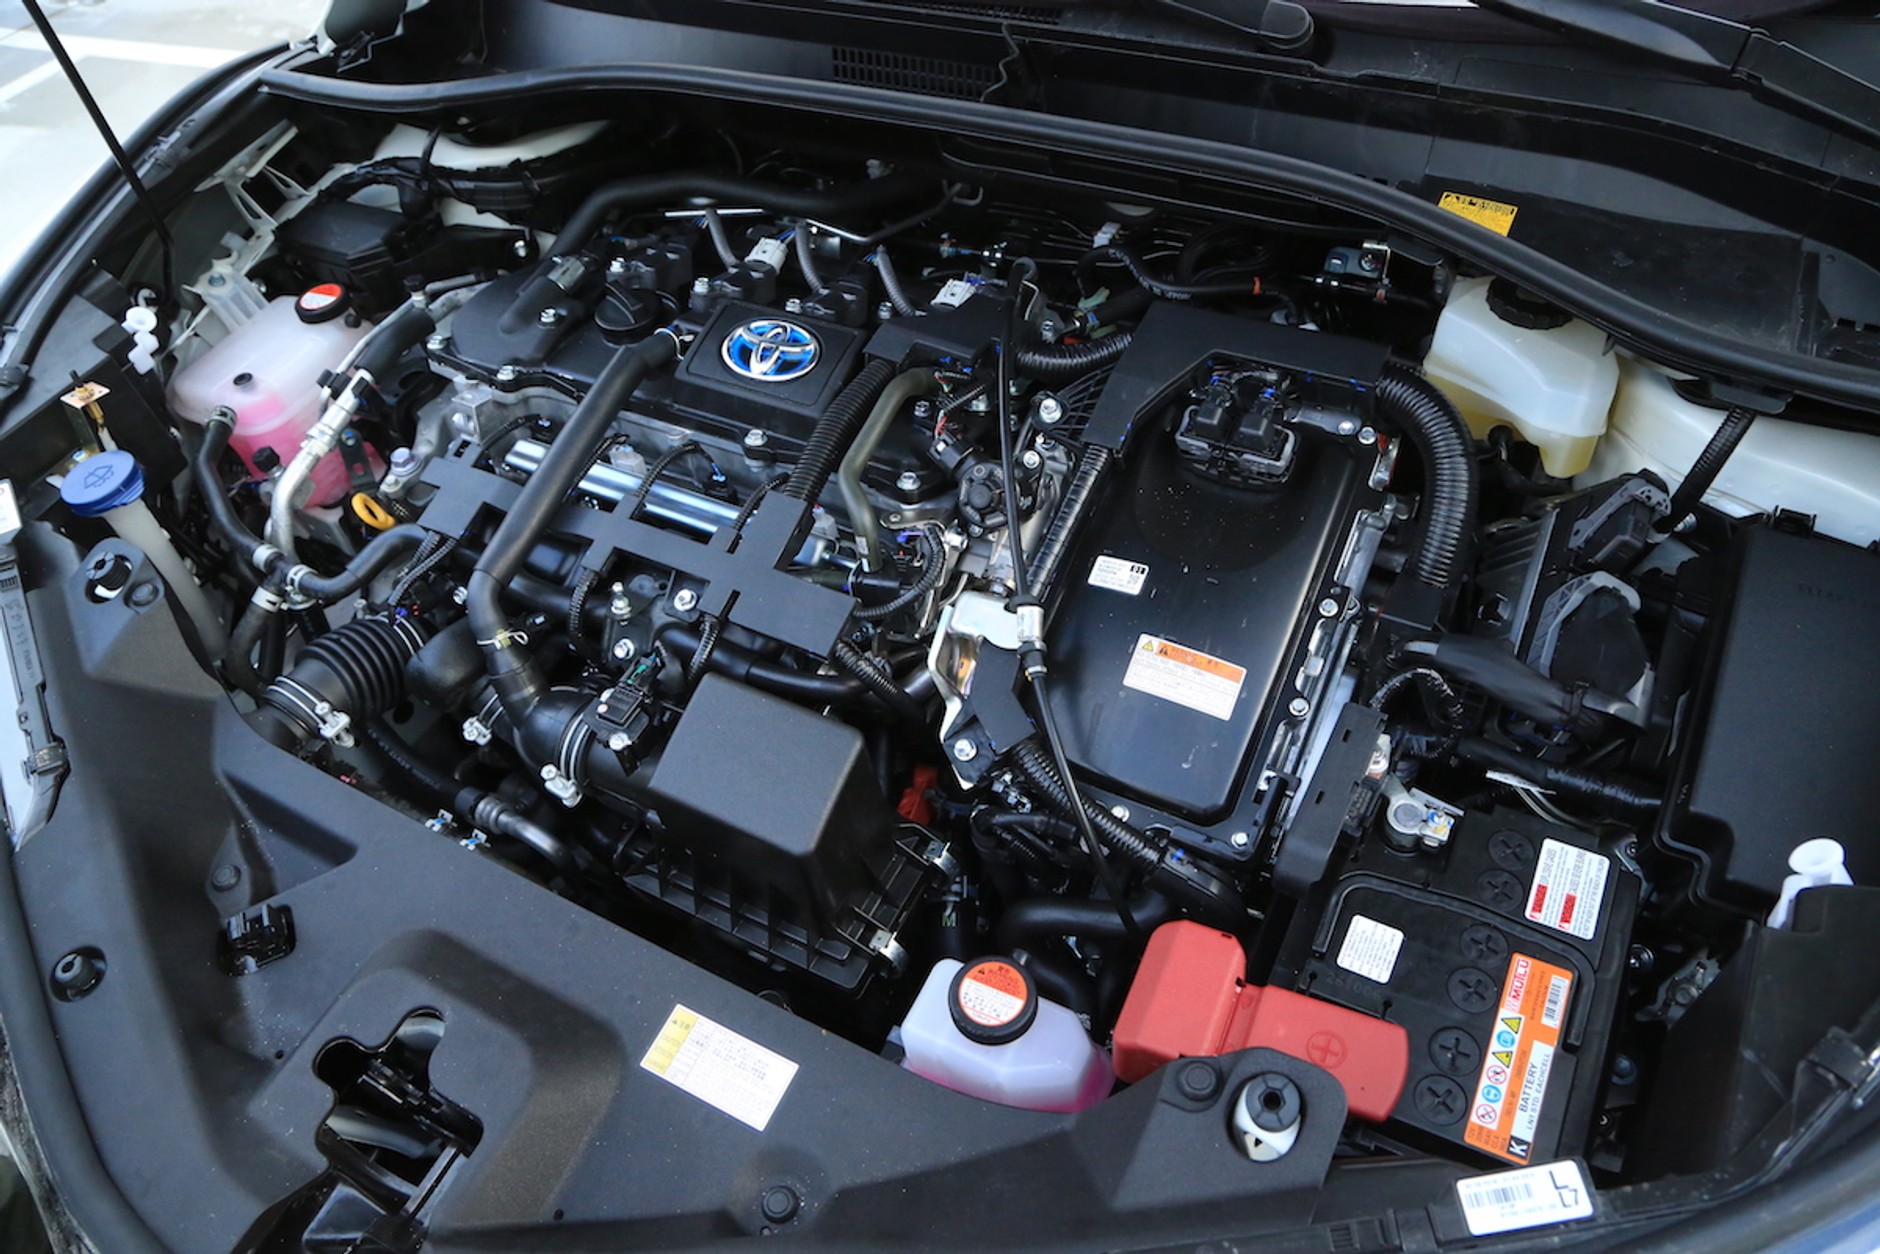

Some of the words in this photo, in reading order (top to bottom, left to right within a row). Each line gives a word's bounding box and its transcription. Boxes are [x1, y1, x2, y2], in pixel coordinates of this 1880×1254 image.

[1510, 958, 1529, 1000] MUTLU
[1519, 1062, 1538, 1112] BATTERY
[1536, 1052, 1550, 1094] EACHCELL
[1509, 1140, 1528, 1157] K
[1549, 1170, 1569, 1189] L
